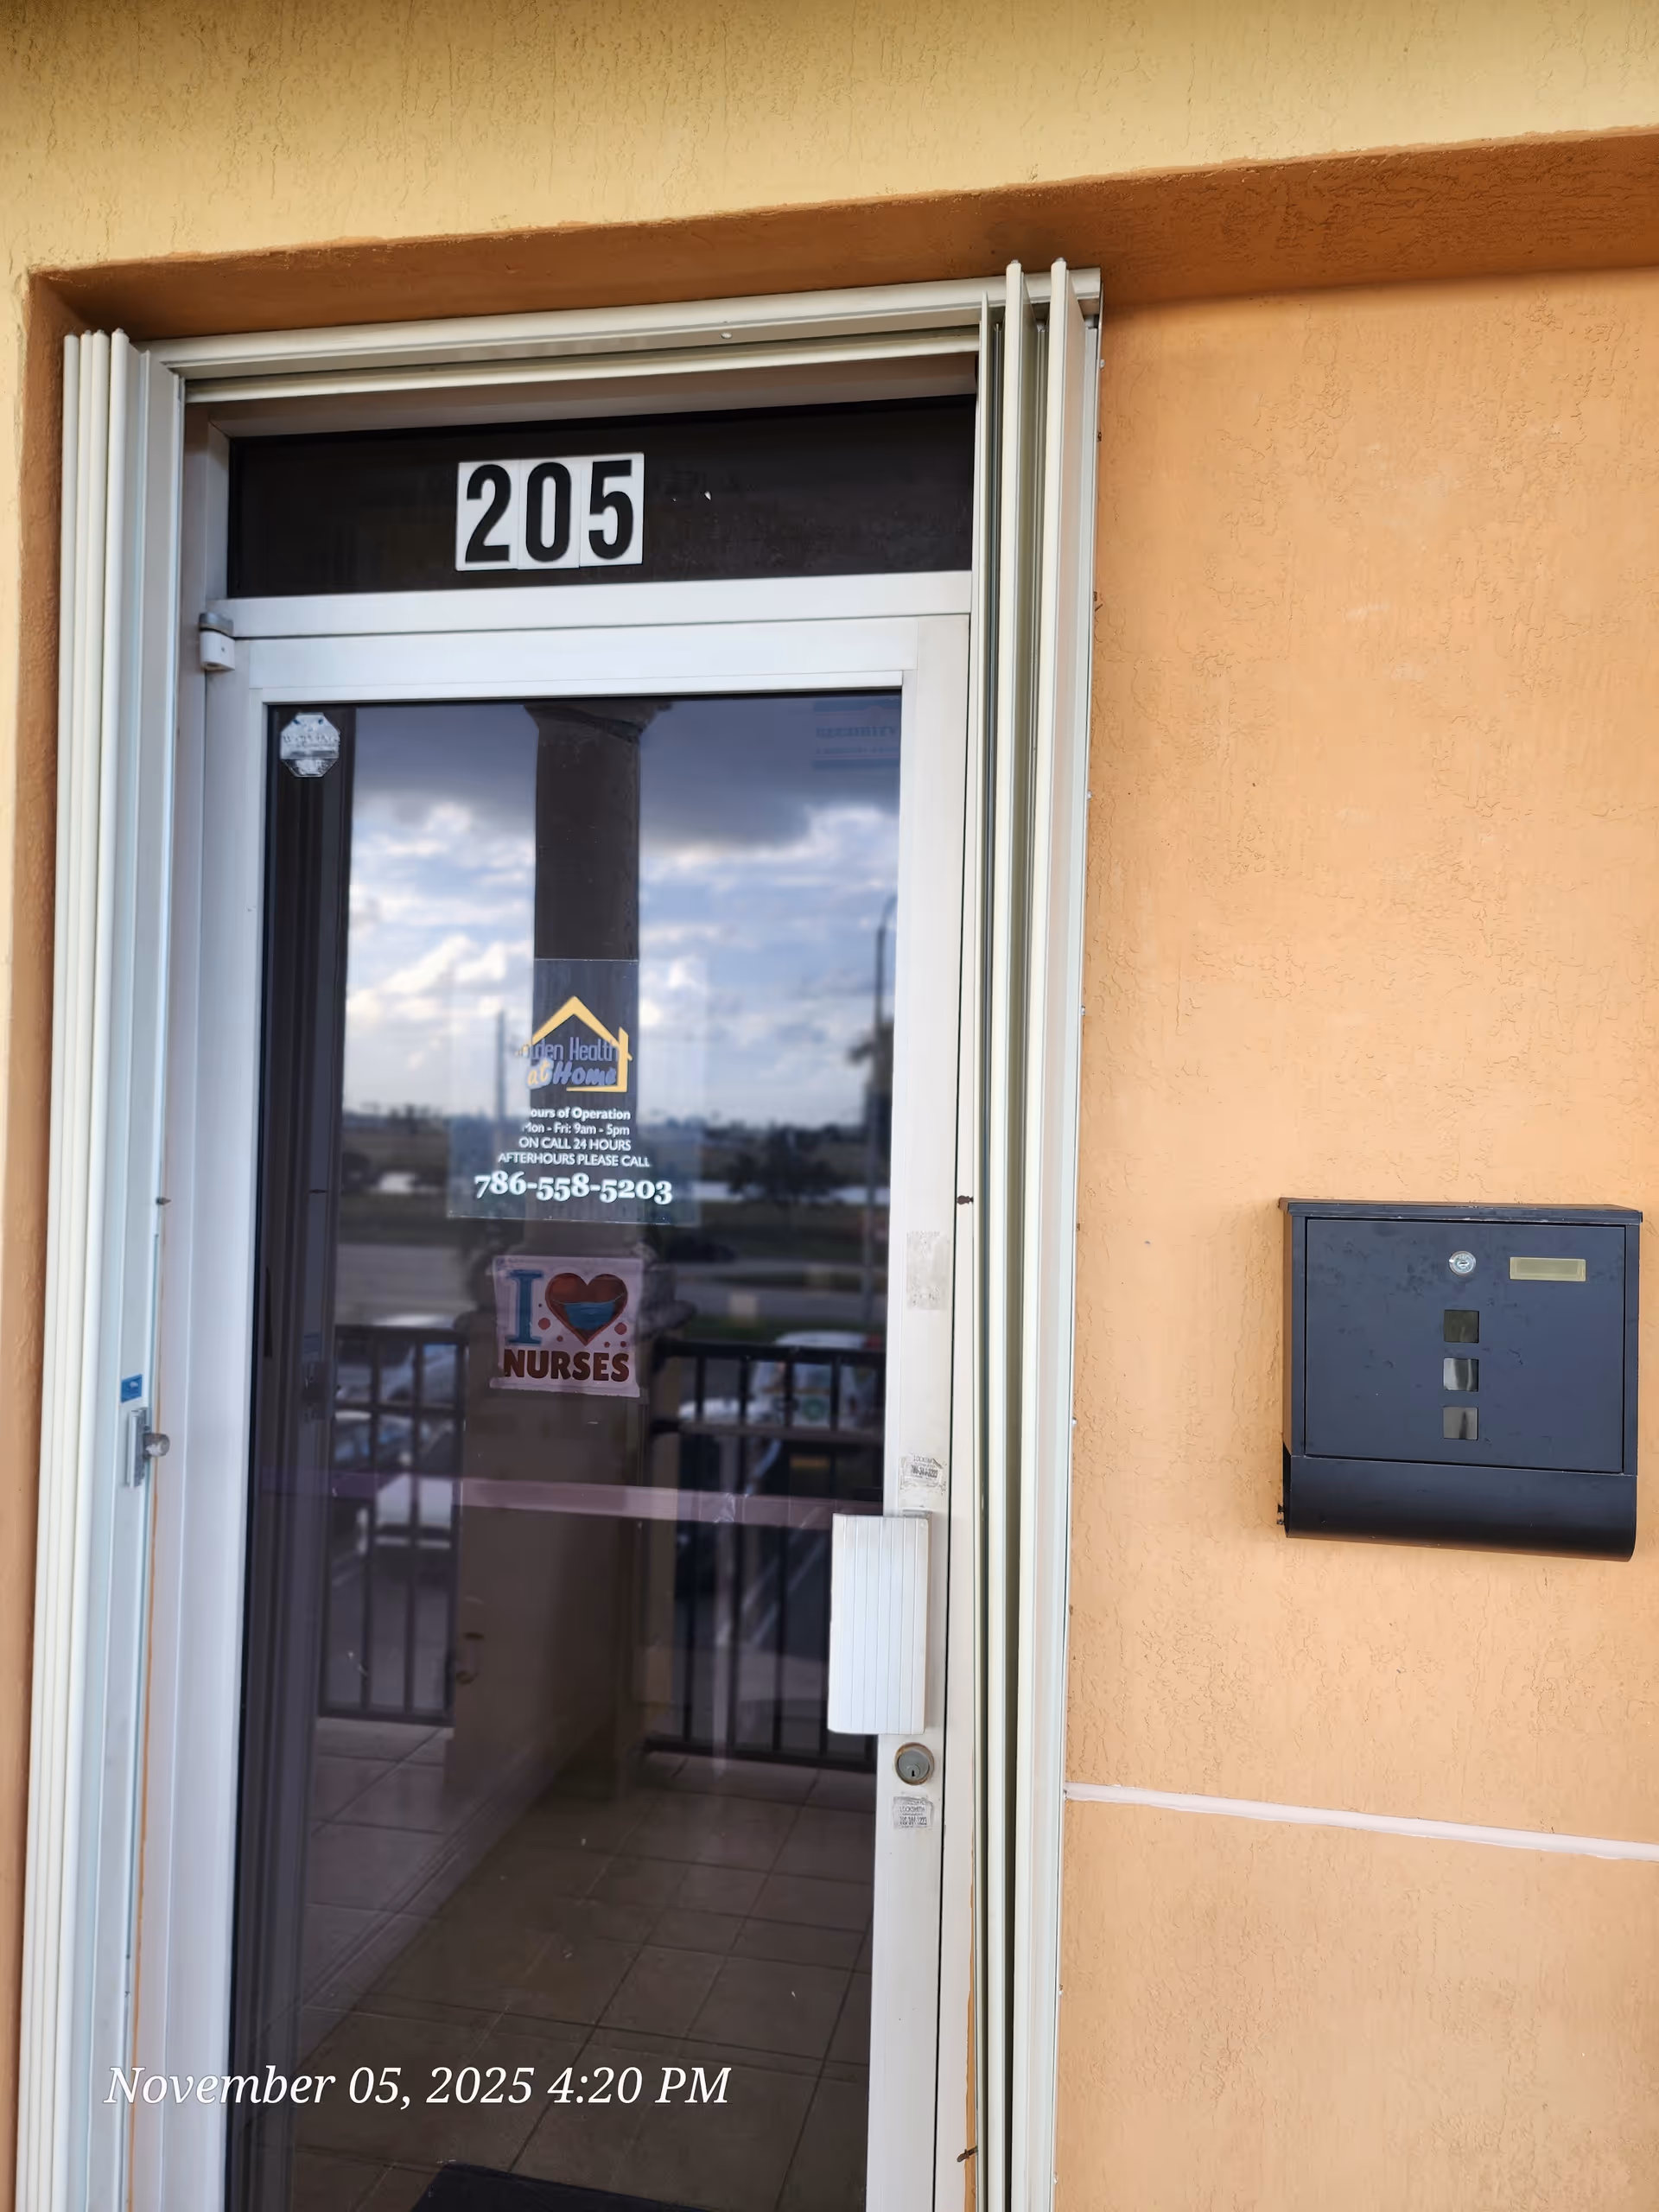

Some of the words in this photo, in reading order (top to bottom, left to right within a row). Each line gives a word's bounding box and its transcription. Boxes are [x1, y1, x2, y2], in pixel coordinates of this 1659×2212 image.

[465, 460, 633, 563] 205
[569, 1037, 619, 1062] Health
[526, 1058, 553, 1087] at
[553, 1061, 617, 1086] Home
[530, 1108, 555, 1118] ours
[558, 1106, 570, 1118] of
[572, 1107, 632, 1122] Operation
[554, 1122, 572, 1135] Fri:
[574, 1123, 597, 1135] 9am
[606, 1126, 630, 1138] 5pm
[518, 1136, 540, 1149] ON
[541, 1137, 572, 1150] CALL
[573, 1137, 588, 1151] 24
[589, 1138, 632, 1152] HOURS
[498, 1152, 575, 1166] AFTERHOURS
[577, 1154, 619, 1166] PLEASE
[621, 1155, 652, 1167] CALL
[474, 1170, 673, 1205] 786-558-5203
[505, 1269, 544, 1345] I
[503, 1349, 630, 1382] NURSES
